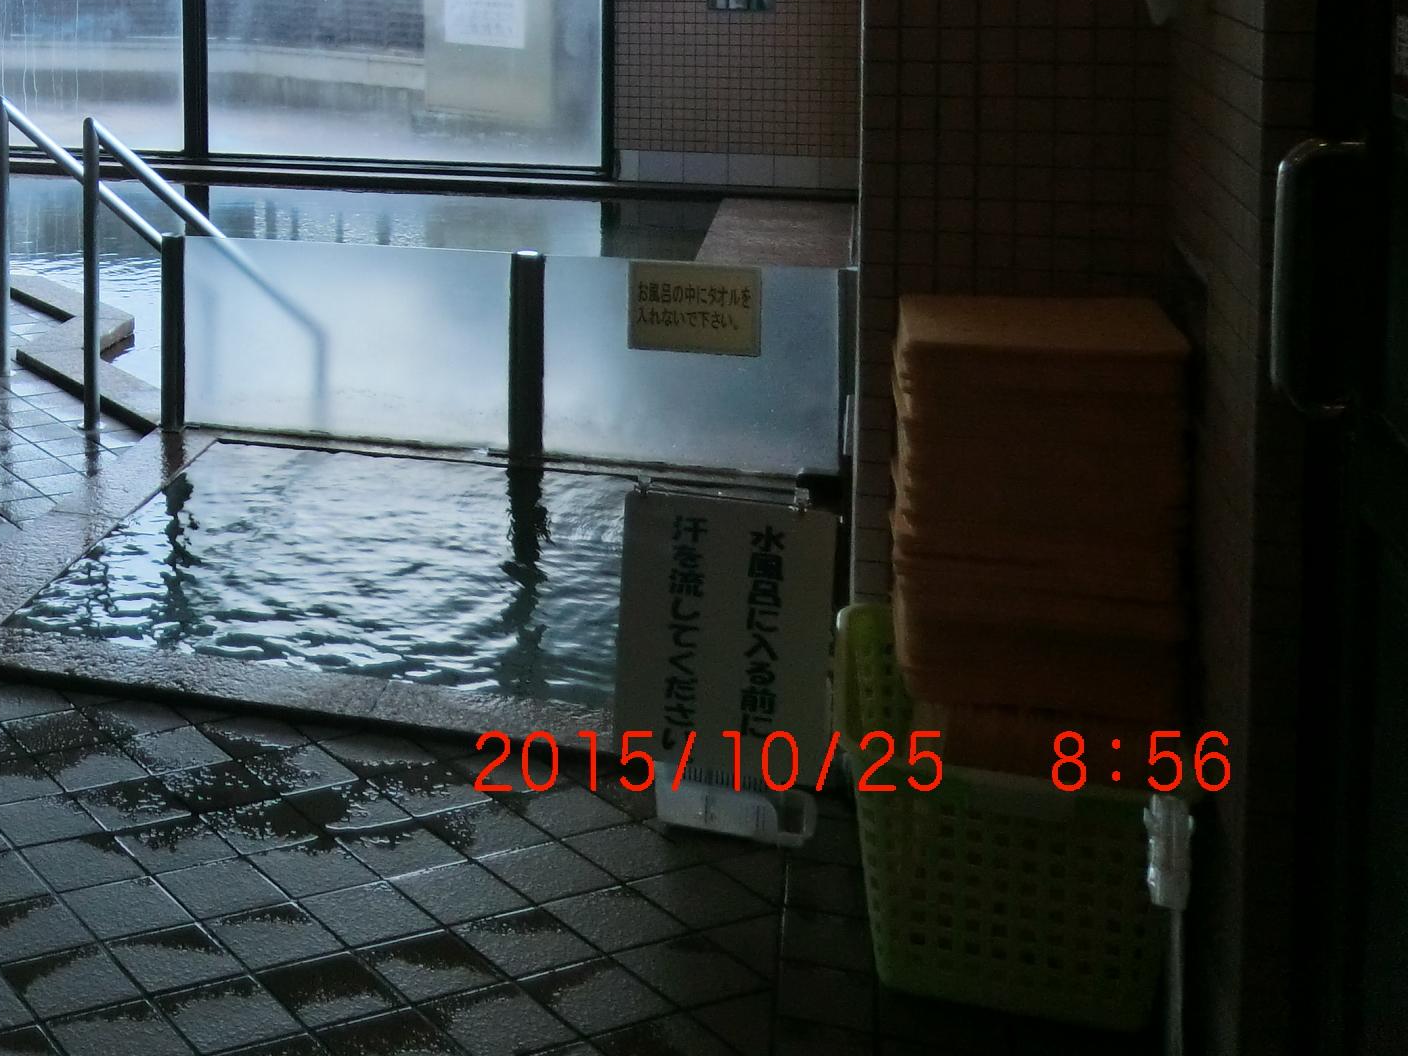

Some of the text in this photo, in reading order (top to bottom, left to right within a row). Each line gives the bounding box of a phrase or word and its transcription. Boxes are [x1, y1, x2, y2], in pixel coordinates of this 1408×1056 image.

[638, 281, 753, 309] お風呂の中にタオルを
[636, 306, 740, 330] 入れないで下さい。
[740, 525, 785, 740] 水風呂に入る前に
